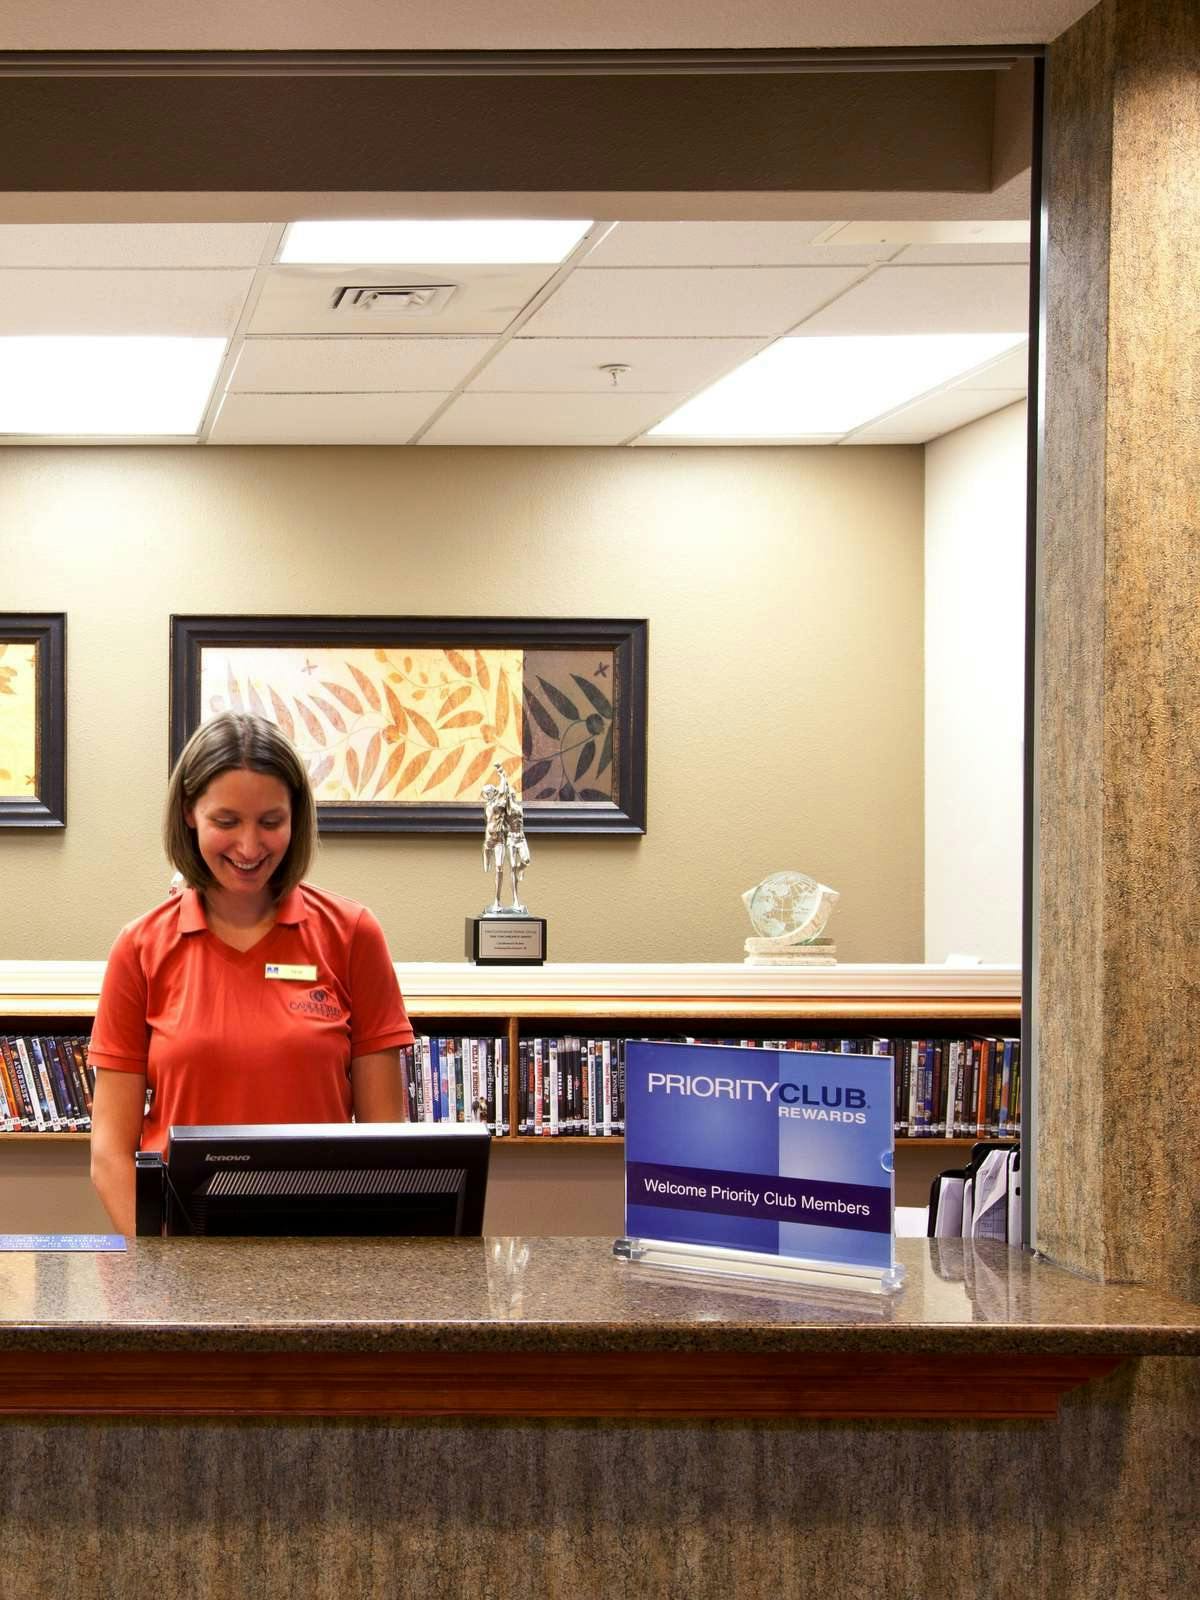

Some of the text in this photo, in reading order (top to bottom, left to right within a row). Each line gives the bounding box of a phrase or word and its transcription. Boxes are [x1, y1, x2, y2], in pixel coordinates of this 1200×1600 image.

[778, 1106, 867, 1124] REWARDS
[205, 1154, 251, 1162] lenovo
[644, 1178, 871, 1216] Welcome Priority Club Members
